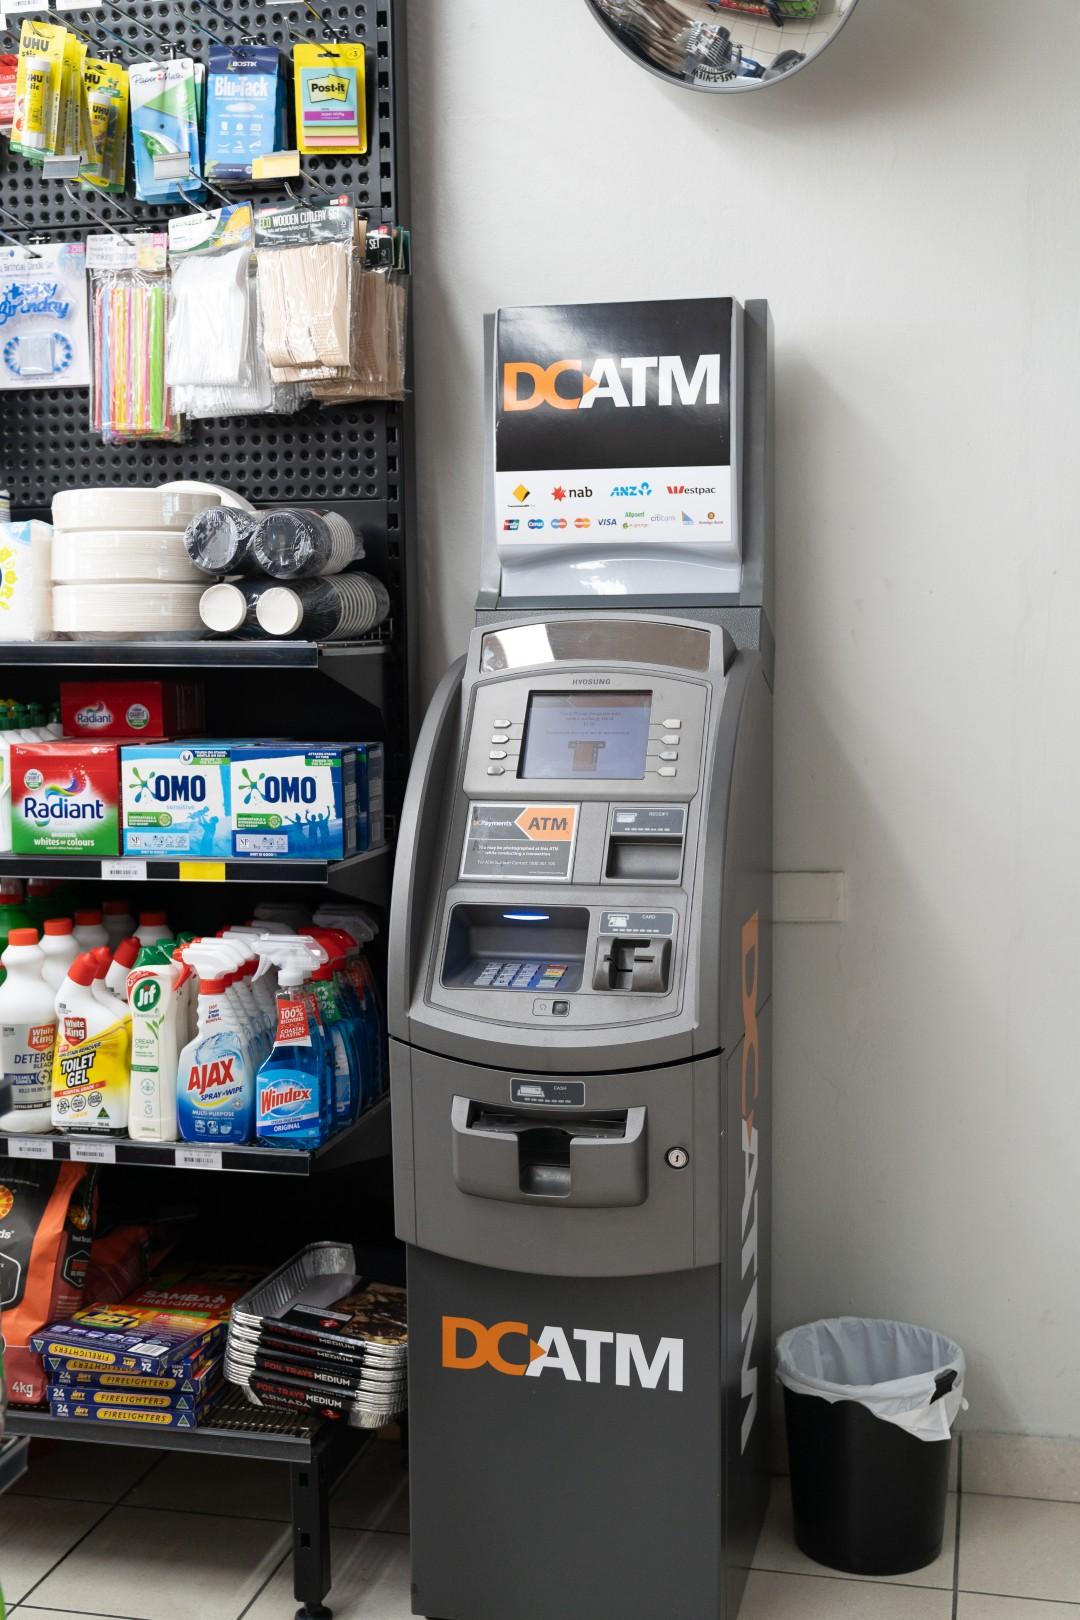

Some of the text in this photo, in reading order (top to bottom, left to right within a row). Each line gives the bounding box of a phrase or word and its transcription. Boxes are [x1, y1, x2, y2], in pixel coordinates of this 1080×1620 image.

[22, 36, 49, 52] UHU
[84, 72, 101, 84] HU
[311, 82, 345, 93] Post-it
[92, 105, 110, 116] UHU
[260, 217, 272, 229] ECO
[272, 213, 299, 227] WOODEN
[300, 209, 327, 223] CUTLERY
[368, 238, 380, 250] SET
[569, 485, 593, 498] nab
[610, 485, 638, 497] ANZ
[666, 484, 717, 496] Westpac
[598, 518, 617, 526] VISA
[77, 713, 113, 724] Radiant
[155, 774, 206, 803] OMO
[264, 775, 317, 804] OMO
[24, 797, 104, 819] Radiant
[528, 817, 568, 831] ATM
[33, 837, 60, 847] whites
[66, 838, 95, 847] colours
[137, 983, 157, 1008] Jif
[280, 1006, 304, 1020] 100%
[65, 1019, 85, 1028] White
[280, 1026, 305, 1035] COASTAL
[31, 1027, 55, 1036] White
[65, 1028, 85, 1040] King
[32, 1035, 54, 1046] King
[134, 1038, 155, 1046] CREAM
[61, 1052, 96, 1074] TOILET
[66, 1069, 89, 1087] GEL
[187, 1058, 234, 1096] AJAX
[200, 1090, 222, 1102] SPRAY
[225, 1085, 244, 1097] WIPE
[260, 1086, 312, 1117] Windex
[273, 1121, 301, 1133] ORIGINAL
[142, 1289, 210, 1303] SAMBA
[136, 1297, 221, 1310] FIRELIGHTERS
[54, 1344, 111, 1361] FIRELIGHTERS
[441, 1315, 684, 1393] DCATM
[141, 1362, 152, 1373] 24
[172, 1368, 184, 1379] 24
[59, 1371, 71, 1380] 24
[105, 1378, 170, 1388] FIRELIGHTERS
[313, 1372, 351, 1387] MEDIUM
[12, 1381, 34, 1398] 4kg
[53, 1387, 65, 1397] 24
[100, 1393, 165, 1405] FIRELIGHTERS
[261, 1392, 312, 1409] ARMADA
[305, 1393, 343, 1409] MEDIUM
[57, 1403, 69, 1413] 24
[103, 1410, 168, 1422] FIRELIGHTERS
